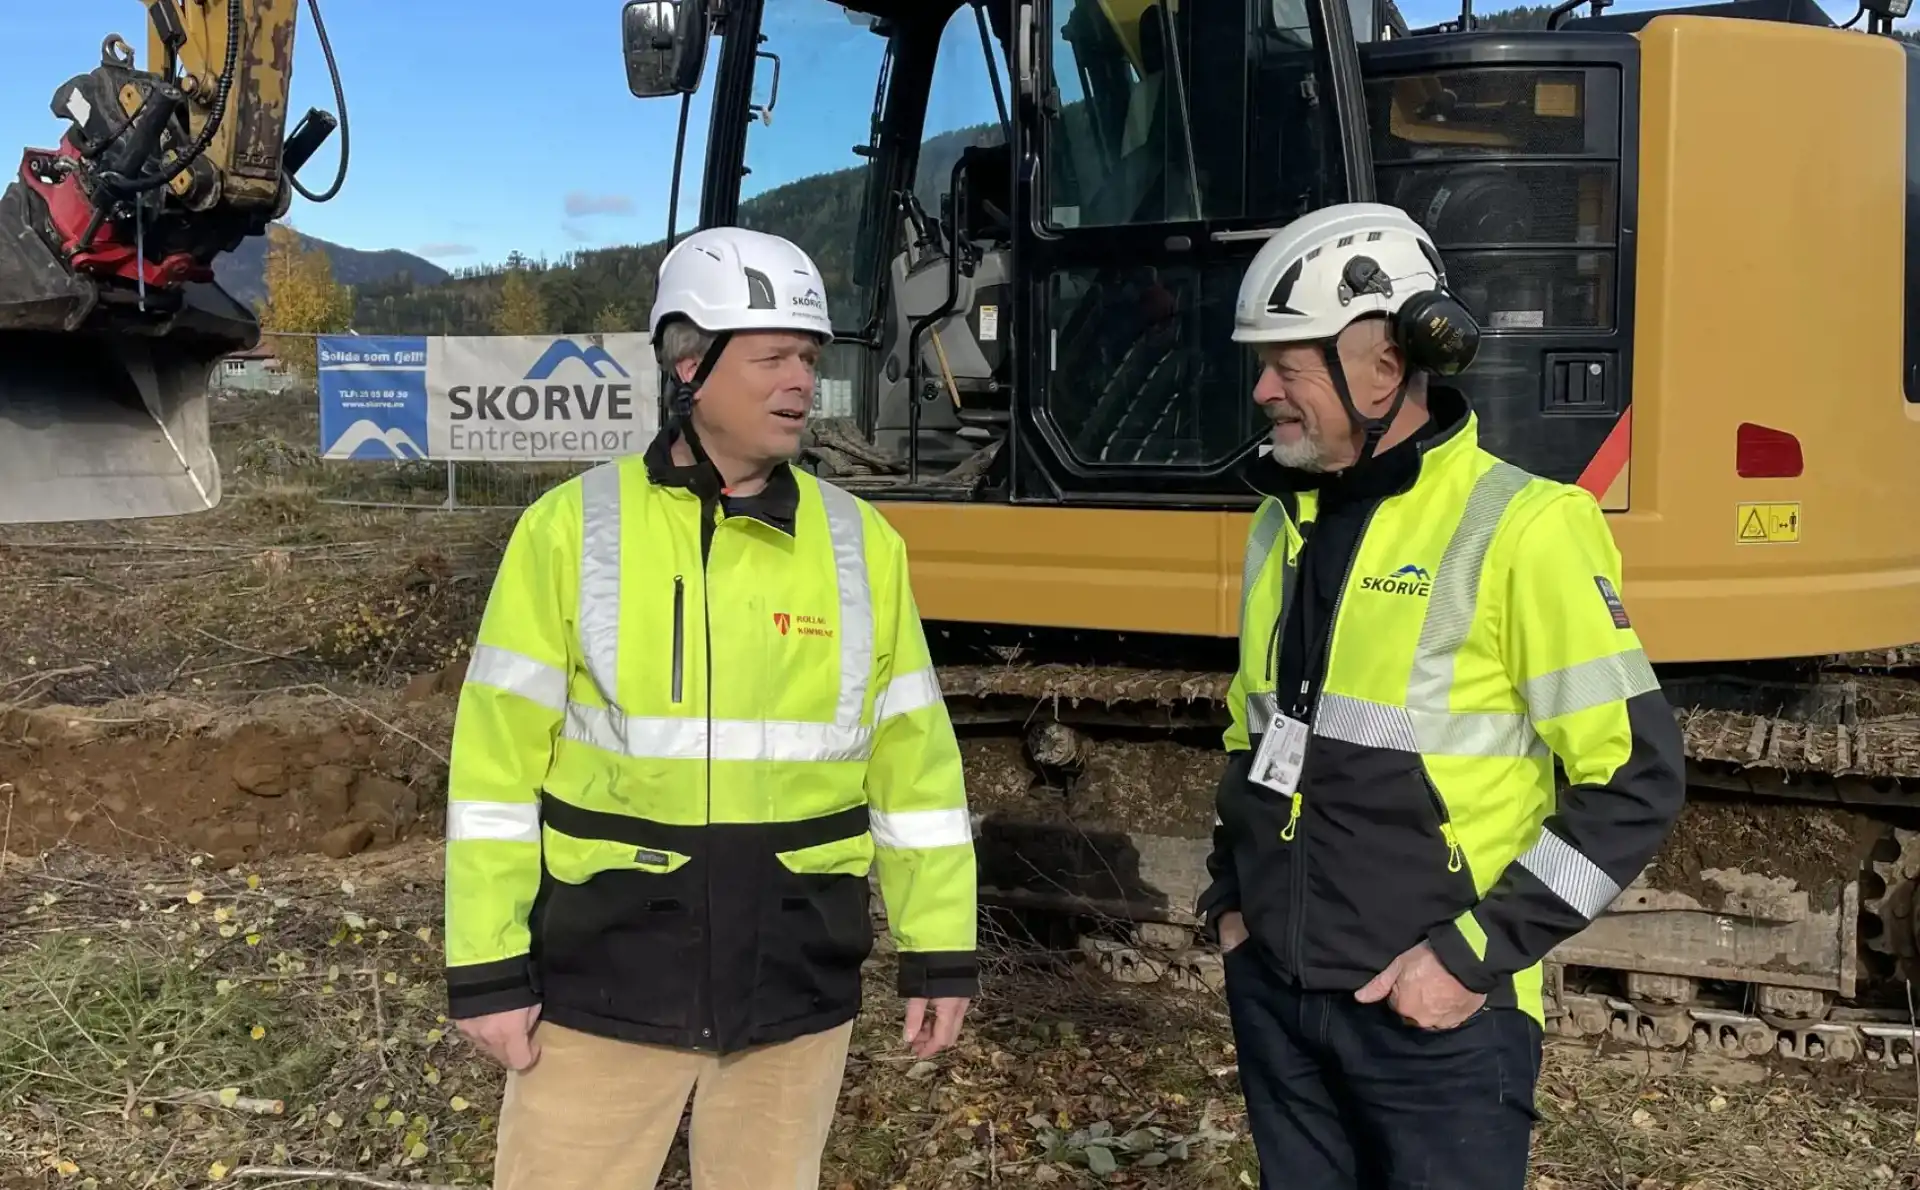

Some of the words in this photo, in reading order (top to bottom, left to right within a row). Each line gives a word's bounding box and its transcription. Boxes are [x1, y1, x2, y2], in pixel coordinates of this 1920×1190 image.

[363, 353, 390, 362] som
[448, 384, 633, 421] SKORVE
[450, 424, 634, 457] Entreprenør
[1360, 577, 1430, 597] SKORVE
